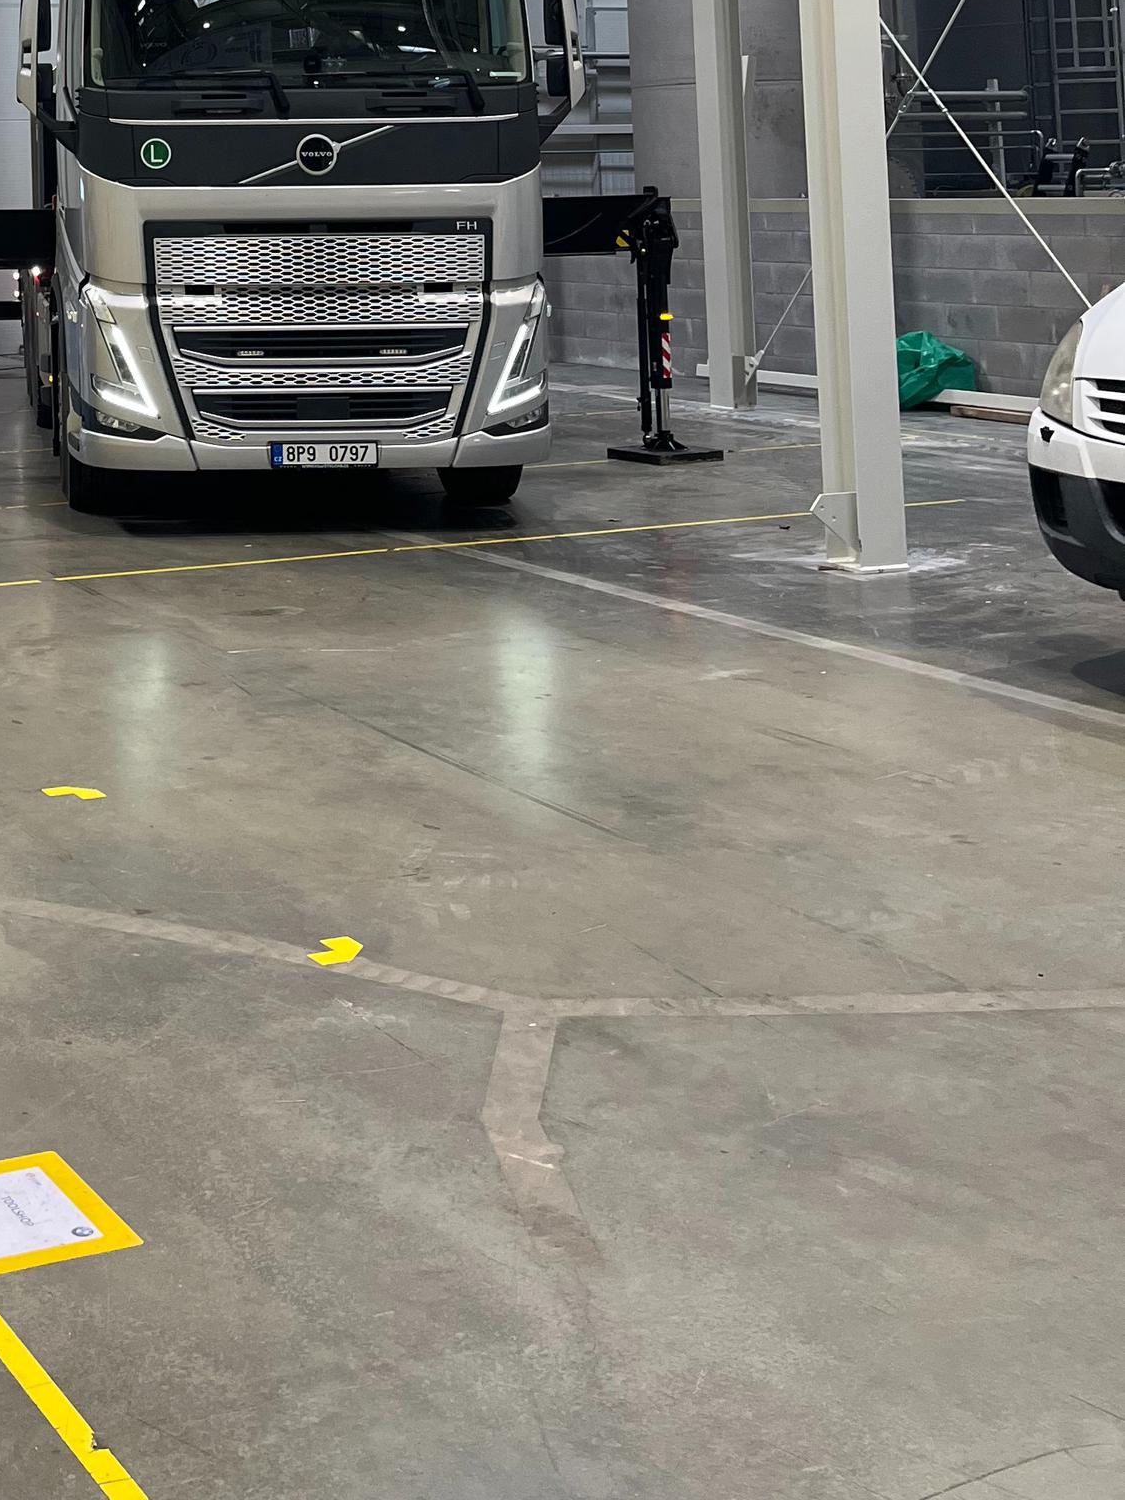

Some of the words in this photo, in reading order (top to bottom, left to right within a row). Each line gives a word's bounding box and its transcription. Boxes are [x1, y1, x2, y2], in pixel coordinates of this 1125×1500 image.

[151, 144, 163, 162] L
[456, 221, 477, 230] FH
[286, 446, 316, 462] 8P9
[329, 445, 369, 462] 0797
[1, 1195, 35, 1227] TOOLSHOP
